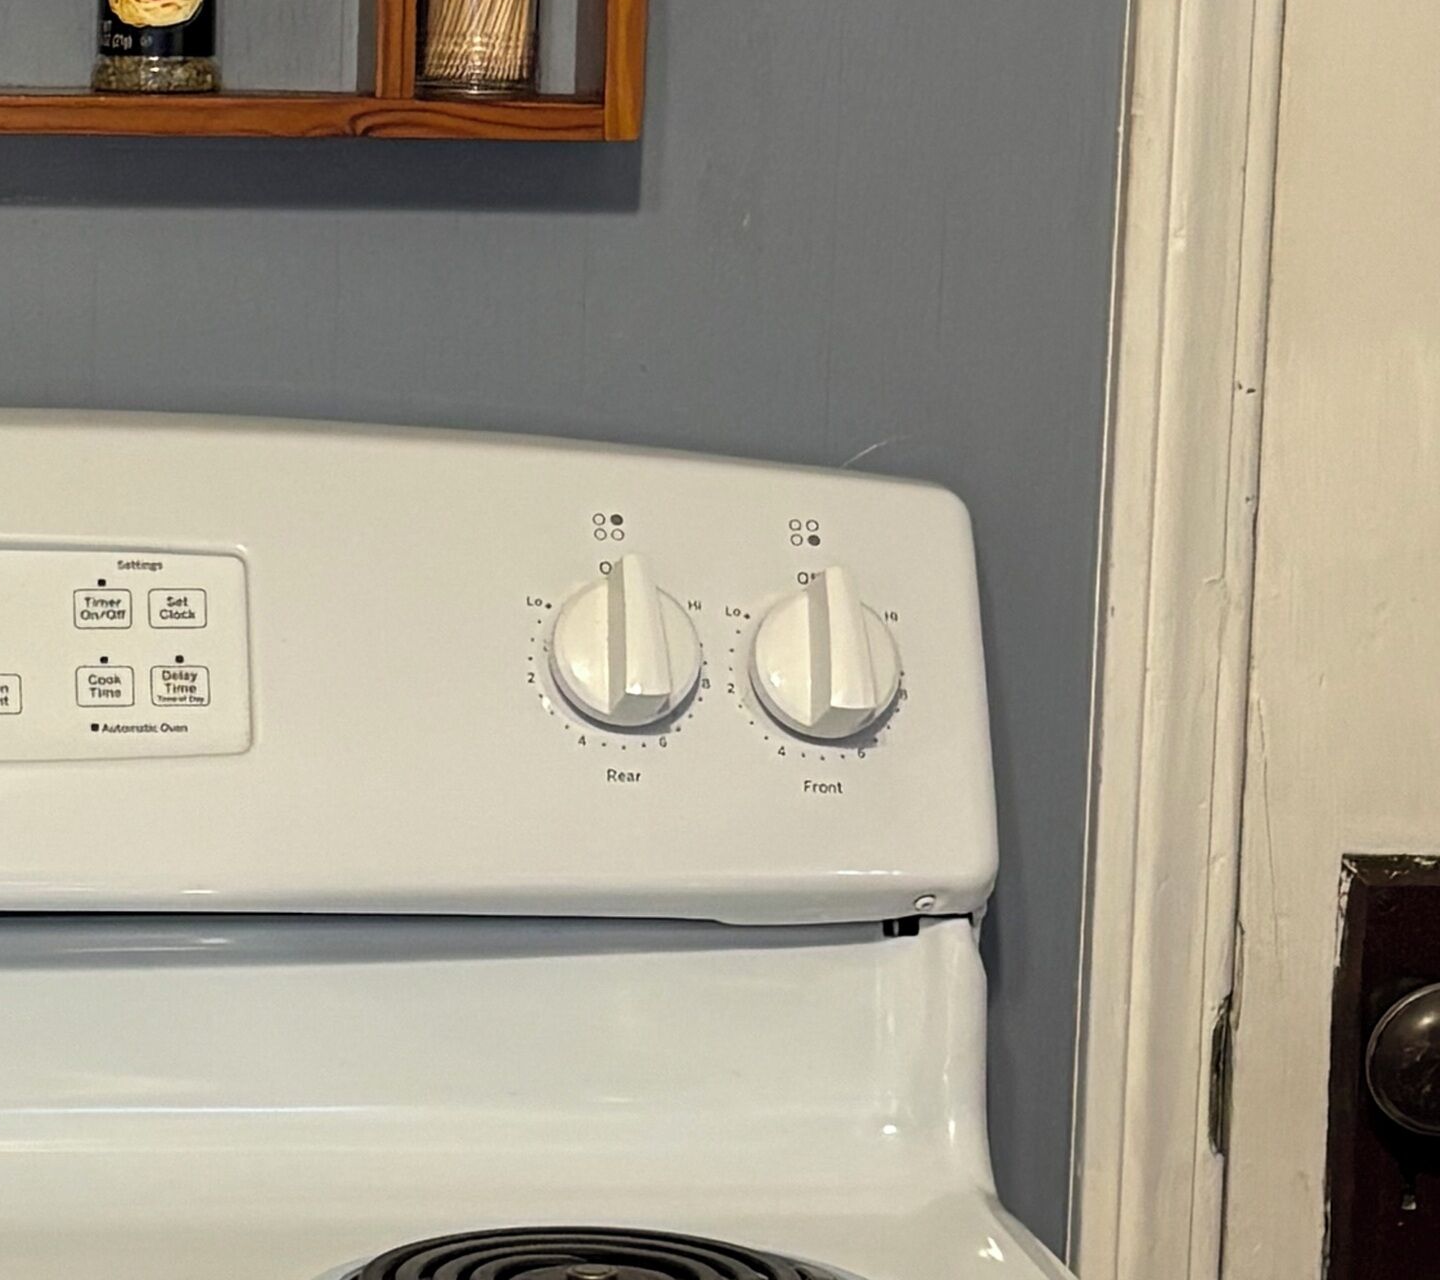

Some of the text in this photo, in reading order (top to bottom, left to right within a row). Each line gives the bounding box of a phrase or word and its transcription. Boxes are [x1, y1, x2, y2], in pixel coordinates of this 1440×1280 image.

[117, 560, 163, 571] Settings
[84, 596, 122, 608] Timer
[167, 596, 188, 607] Set
[526, 596, 543, 607] Lo
[80, 609, 126, 620] On/Off
[159, 609, 196, 620] Clock
[725, 607, 741, 617] Lo
[88, 674, 121, 685] Cook
[162, 670, 198, 683] Delay
[527, 673, 535, 684] 2
[89, 687, 122, 698] Time
[164, 683, 197, 694] Time
[726, 683, 735, 694] 2
[102, 723, 188, 733] Automatic Oven
[578, 736, 587, 747] 4
[777, 746, 786, 756] 4
[606, 770, 642, 783] Rear
[804, 780, 843, 794] Front
